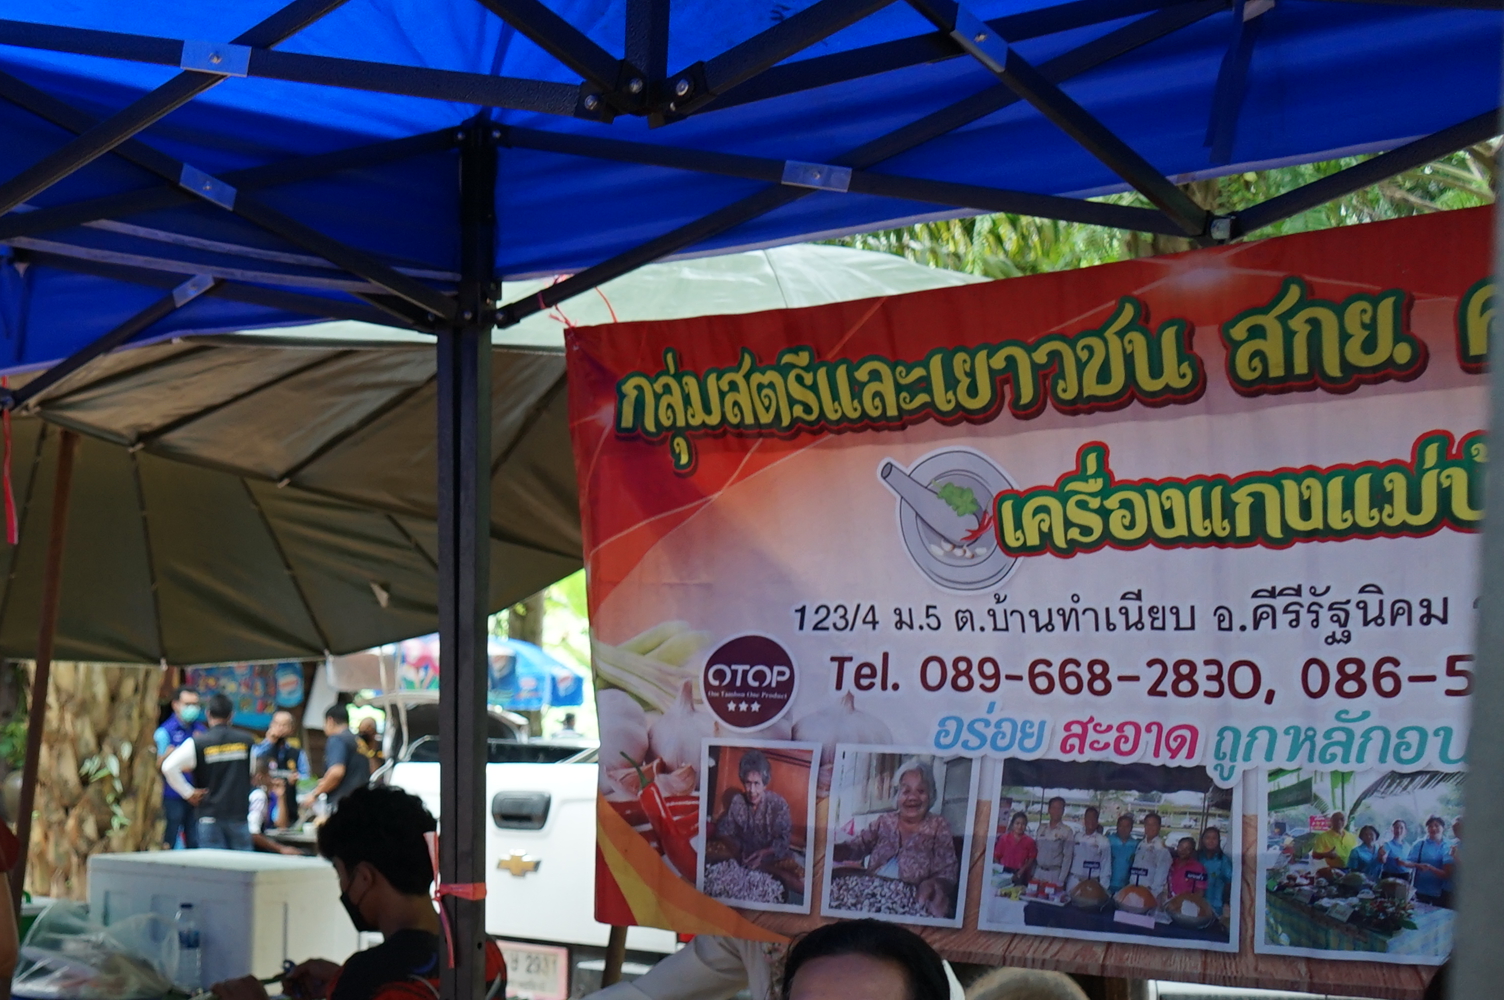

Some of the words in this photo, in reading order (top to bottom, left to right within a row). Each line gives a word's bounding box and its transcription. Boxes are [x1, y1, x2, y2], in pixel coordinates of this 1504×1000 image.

[618, 300, 1196, 467] กลุ่มสตรีและเยาวชน
[1226, 281, 1413, 380] สกย.
[794, 603, 880, 632] 123/4
[893, 604, 943, 632] ม.5
[707, 663, 791, 688] OTOP
[829, 651, 901, 692] Tel.
[919, 654, 1277, 706] 089-668-2830,
[934, 701, 1048, 753] อร่อย
[1059, 715, 1200, 761] สะอาด
